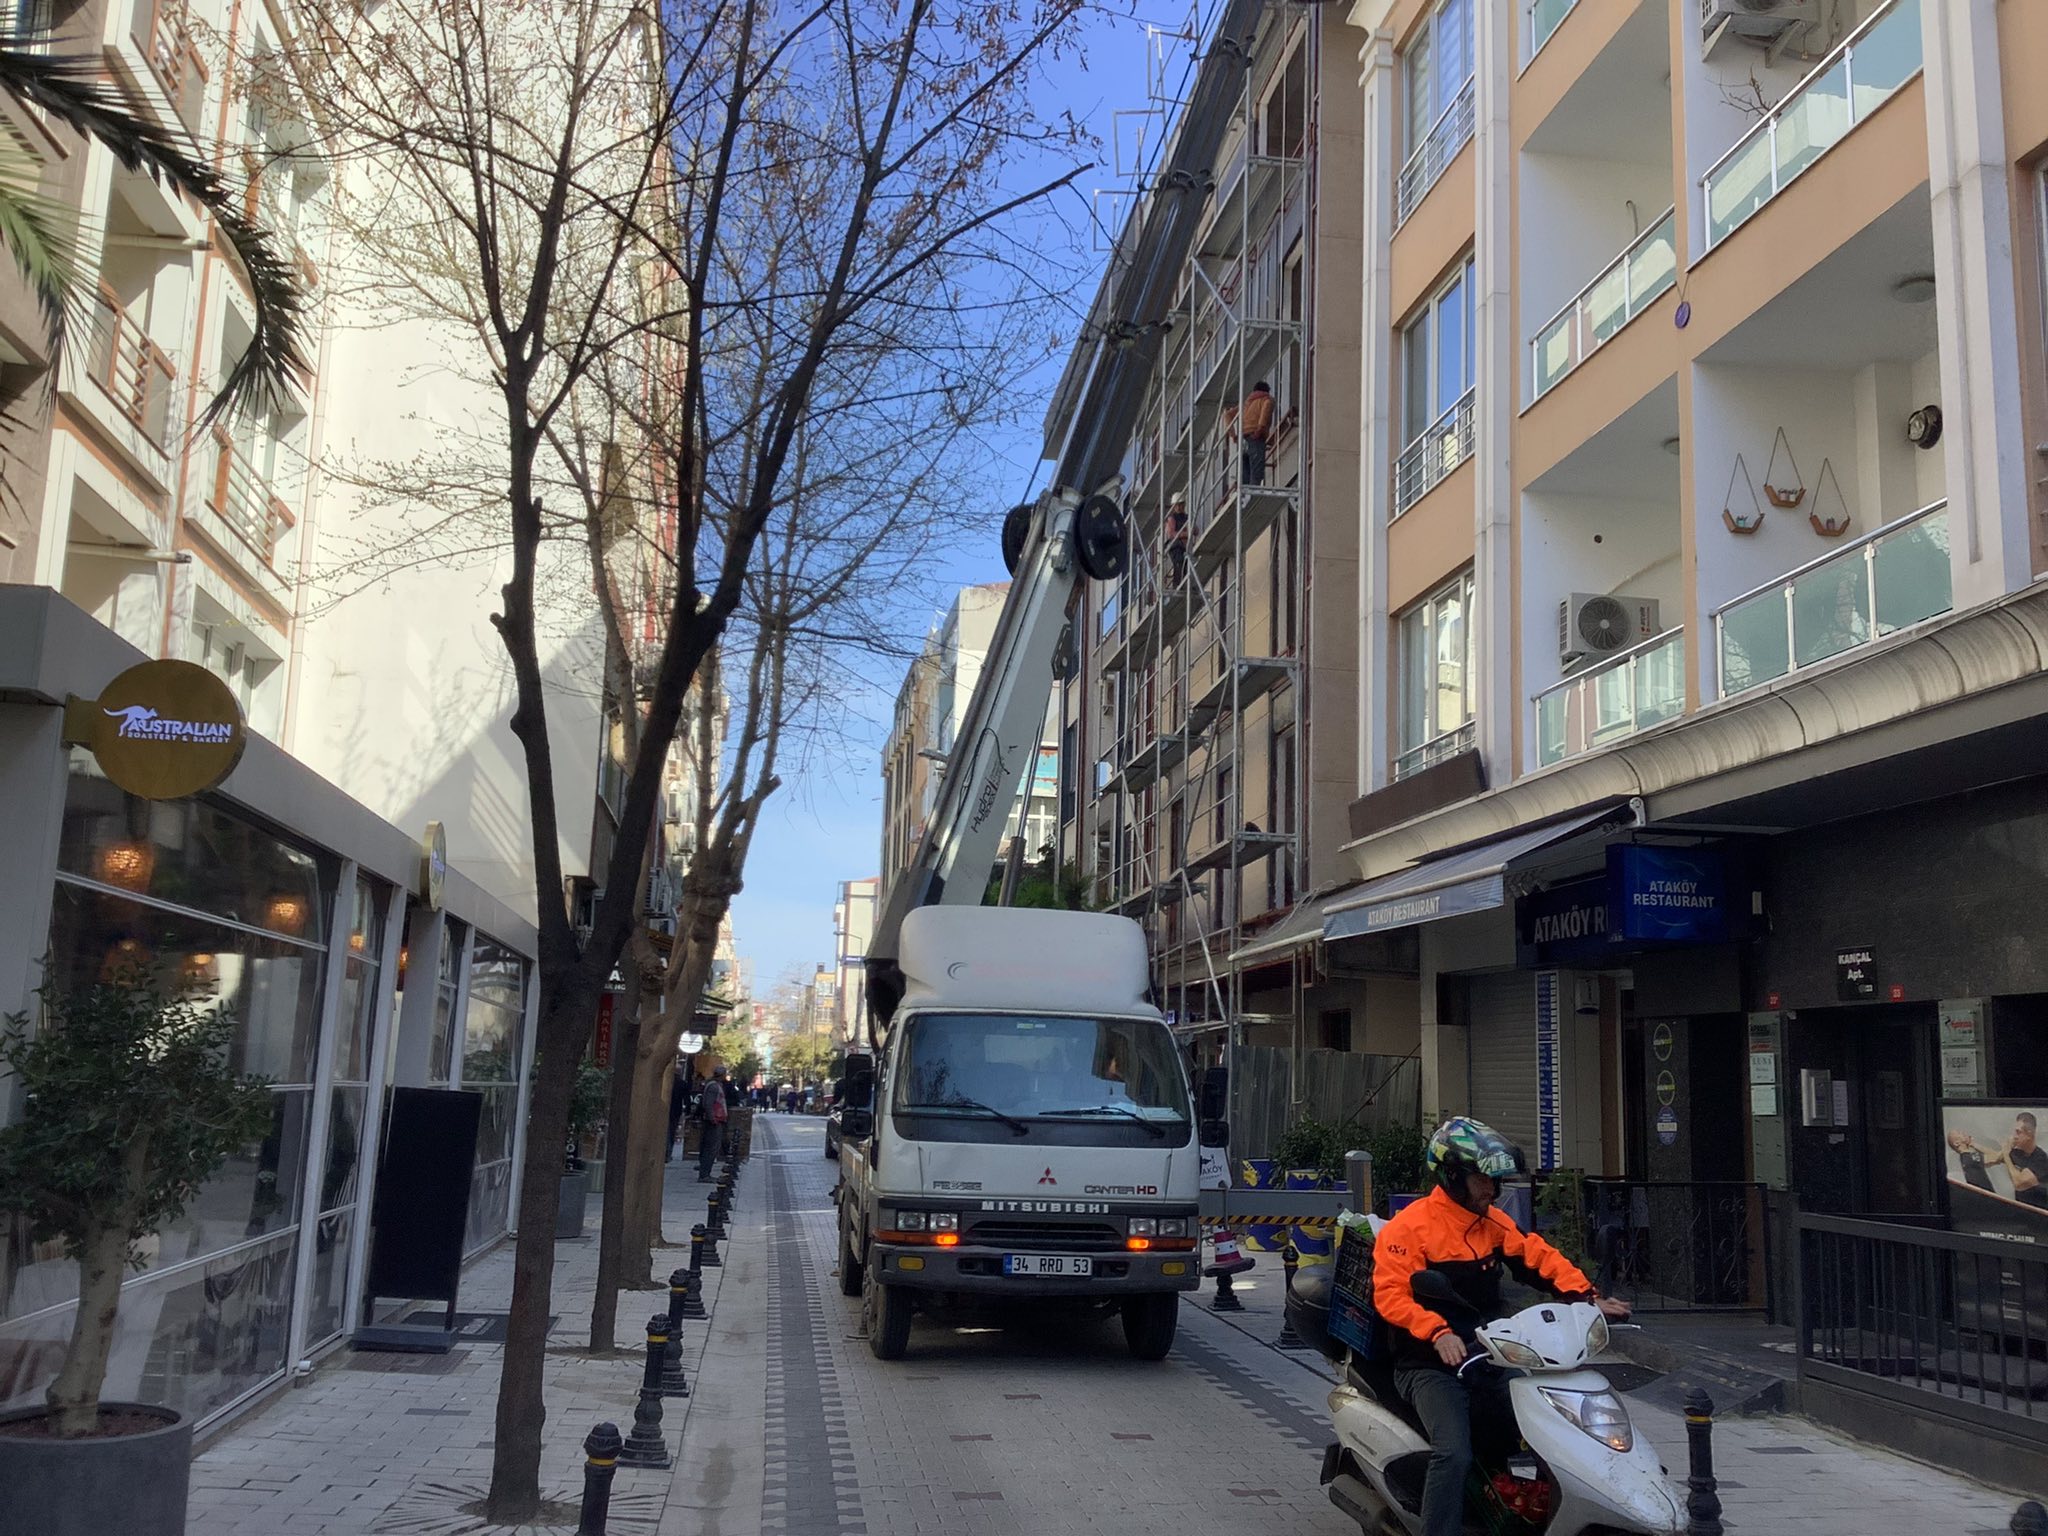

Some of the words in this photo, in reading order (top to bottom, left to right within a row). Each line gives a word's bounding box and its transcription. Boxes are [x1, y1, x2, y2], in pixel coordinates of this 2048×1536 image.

[128, 719, 232, 736] AUSTRALIAN
[128, 731, 177, 741] ROASTERY
[193, 736, 230, 744] BAKERY
[1649, 879, 1698, 894] ATAKÖY
[1633, 893, 1715, 909] RESTAURANT
[1368, 904, 1393, 928] ATAKÖY
[1392, 896, 1440, 921] RESTAURANT
[1534, 905, 1591, 944] ATAKÖY
[1838, 951, 1873, 966] KANÇAL
[1202, 1164, 1223, 1175] AKÖY
[1084, 1185, 1135, 1195] CANTER
[1137, 1185, 1157, 1195] HD
[981, 1201, 1110, 1214] MITSUBISHI
[1013, 1257, 1029, 1272] 34
[1039, 1258, 1063, 1273] RRD
[1073, 1258, 1089, 1273] 53
